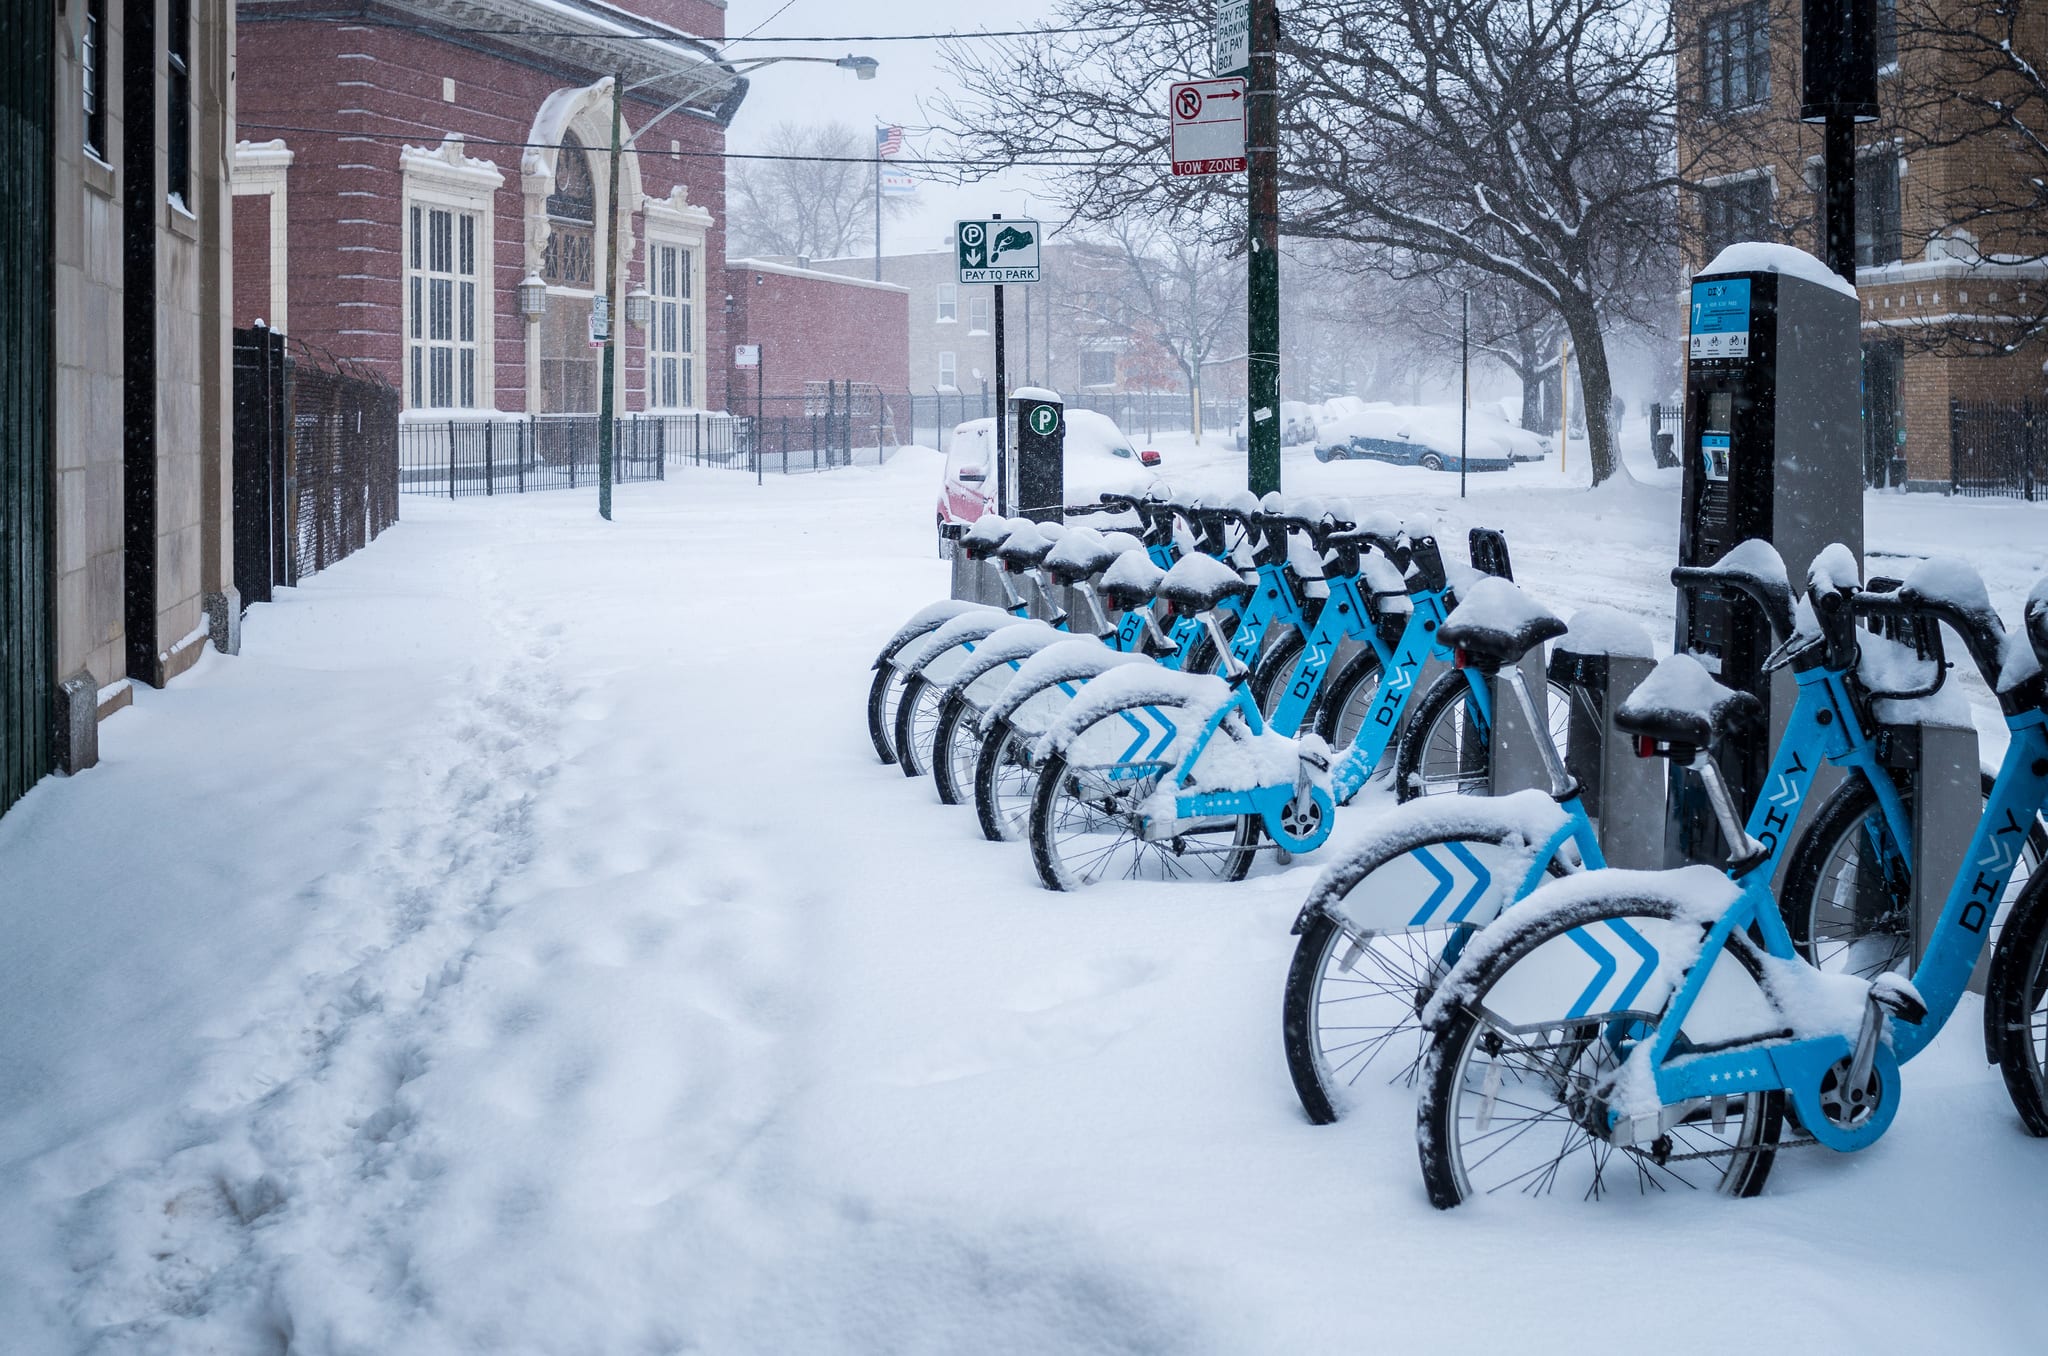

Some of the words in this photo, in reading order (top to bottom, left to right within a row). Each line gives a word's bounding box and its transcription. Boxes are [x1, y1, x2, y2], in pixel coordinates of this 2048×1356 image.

[1219, 8, 1234, 25] PAY
[1235, 4, 1249, 20] FOR
[1219, 41, 1229, 55] AT
[1230, 35, 1244, 52] PAY
[1218, 54, 1233, 70] BOX
[1177, 161, 1202, 174] TOW
[1208, 159, 1241, 172] ZONE
[968, 228, 979, 242] P
[965, 270, 986, 280] PAY
[989, 270, 1002, 280] TO
[1006, 270, 1034, 279] PARK
[1039, 410, 1052, 431] P
